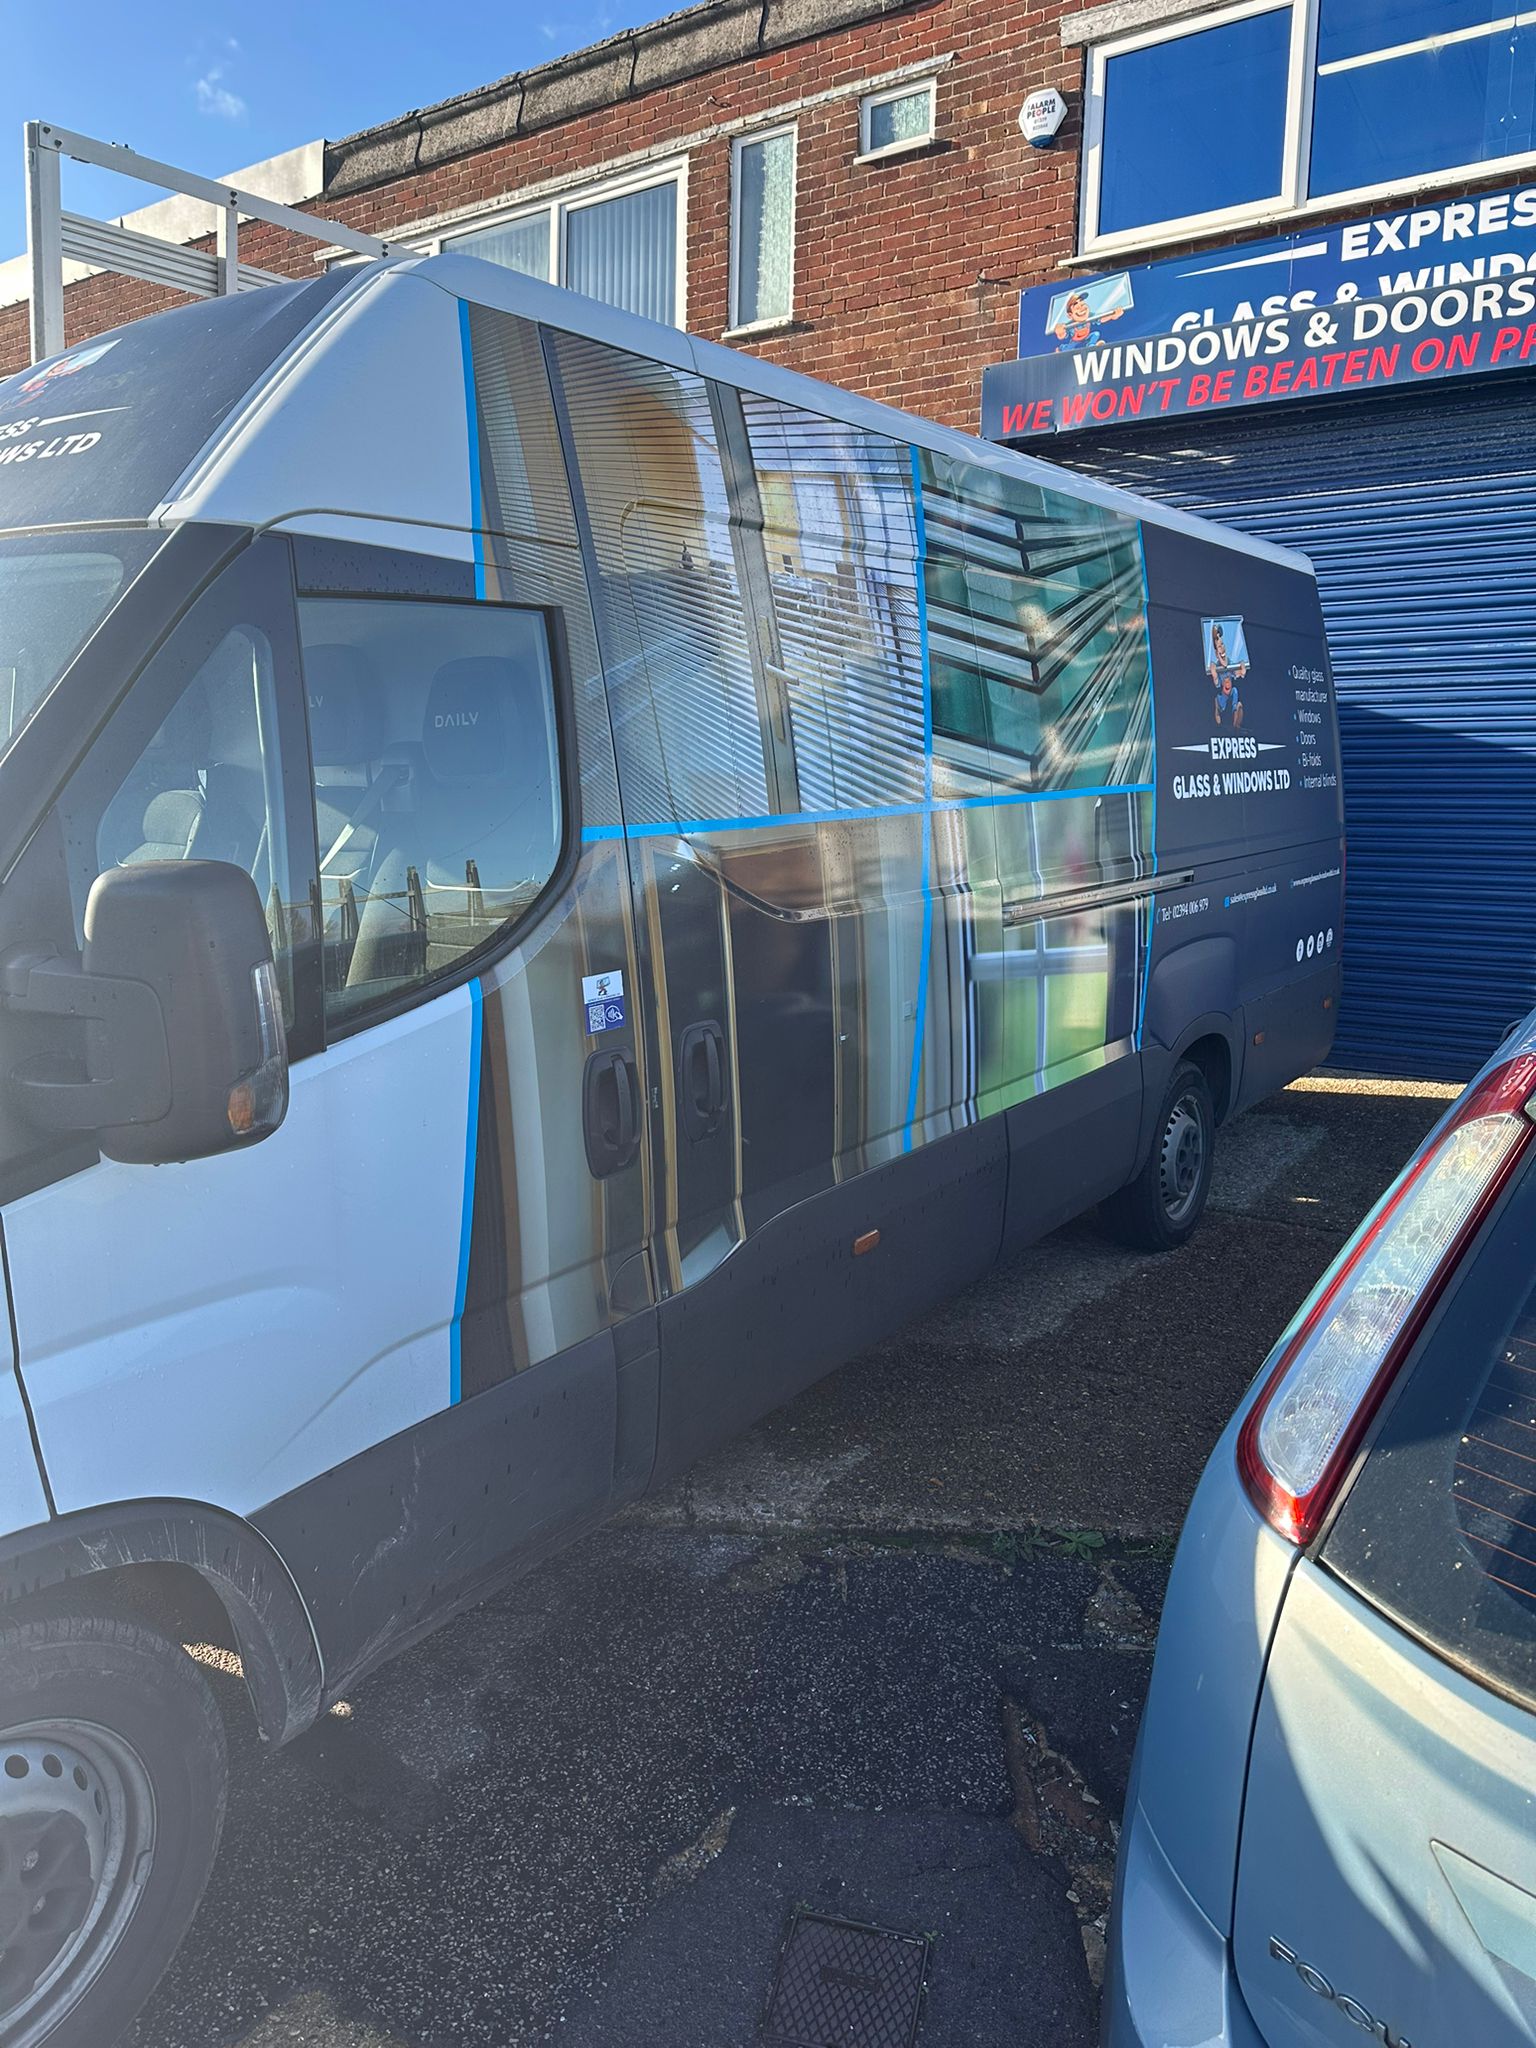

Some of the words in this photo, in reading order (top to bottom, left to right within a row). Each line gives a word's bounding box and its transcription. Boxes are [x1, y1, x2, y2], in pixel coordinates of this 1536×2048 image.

[1027, 105, 1056, 119] PEOPLE
[1030, 98, 1056, 110] ALARM
[1073, 318, 1290, 386] WINDOWS
[1304, 311, 1339, 348] &
[1353, 276, 1536, 341] DOORS
[1002, 400, 1053, 433] WE
[1062, 378, 1181, 426] WON'T
[1187, 369, 1235, 407] BE
[1243, 344, 1400, 398] BEATEN
[1411, 332, 1481, 373] ON
[37, 432, 102, 459] LTD
[1292, 664, 1311, 683] Quality
[1311, 668, 1325, 683] glass
[435, 711, 479, 728] DAILY
[1297, 709, 1322, 723] Windows
[1300, 731, 1316, 745] Doors
[1210, 737, 1257, 760] EXPRESS
[1302, 752, 1322, 767] Bi-folds
[1173, 773, 1211, 799] GLASS
[1213, 773, 1221, 796] &
[1222, 770, 1273, 795] WINDOWS
[1273, 769, 1291, 790] LTD
[1322, 772, 1337, 787] blinds
[1172, 903, 1188, 919] 02394
[1188, 900, 1199, 914] 006
[1199, 898, 1209, 912] 979
